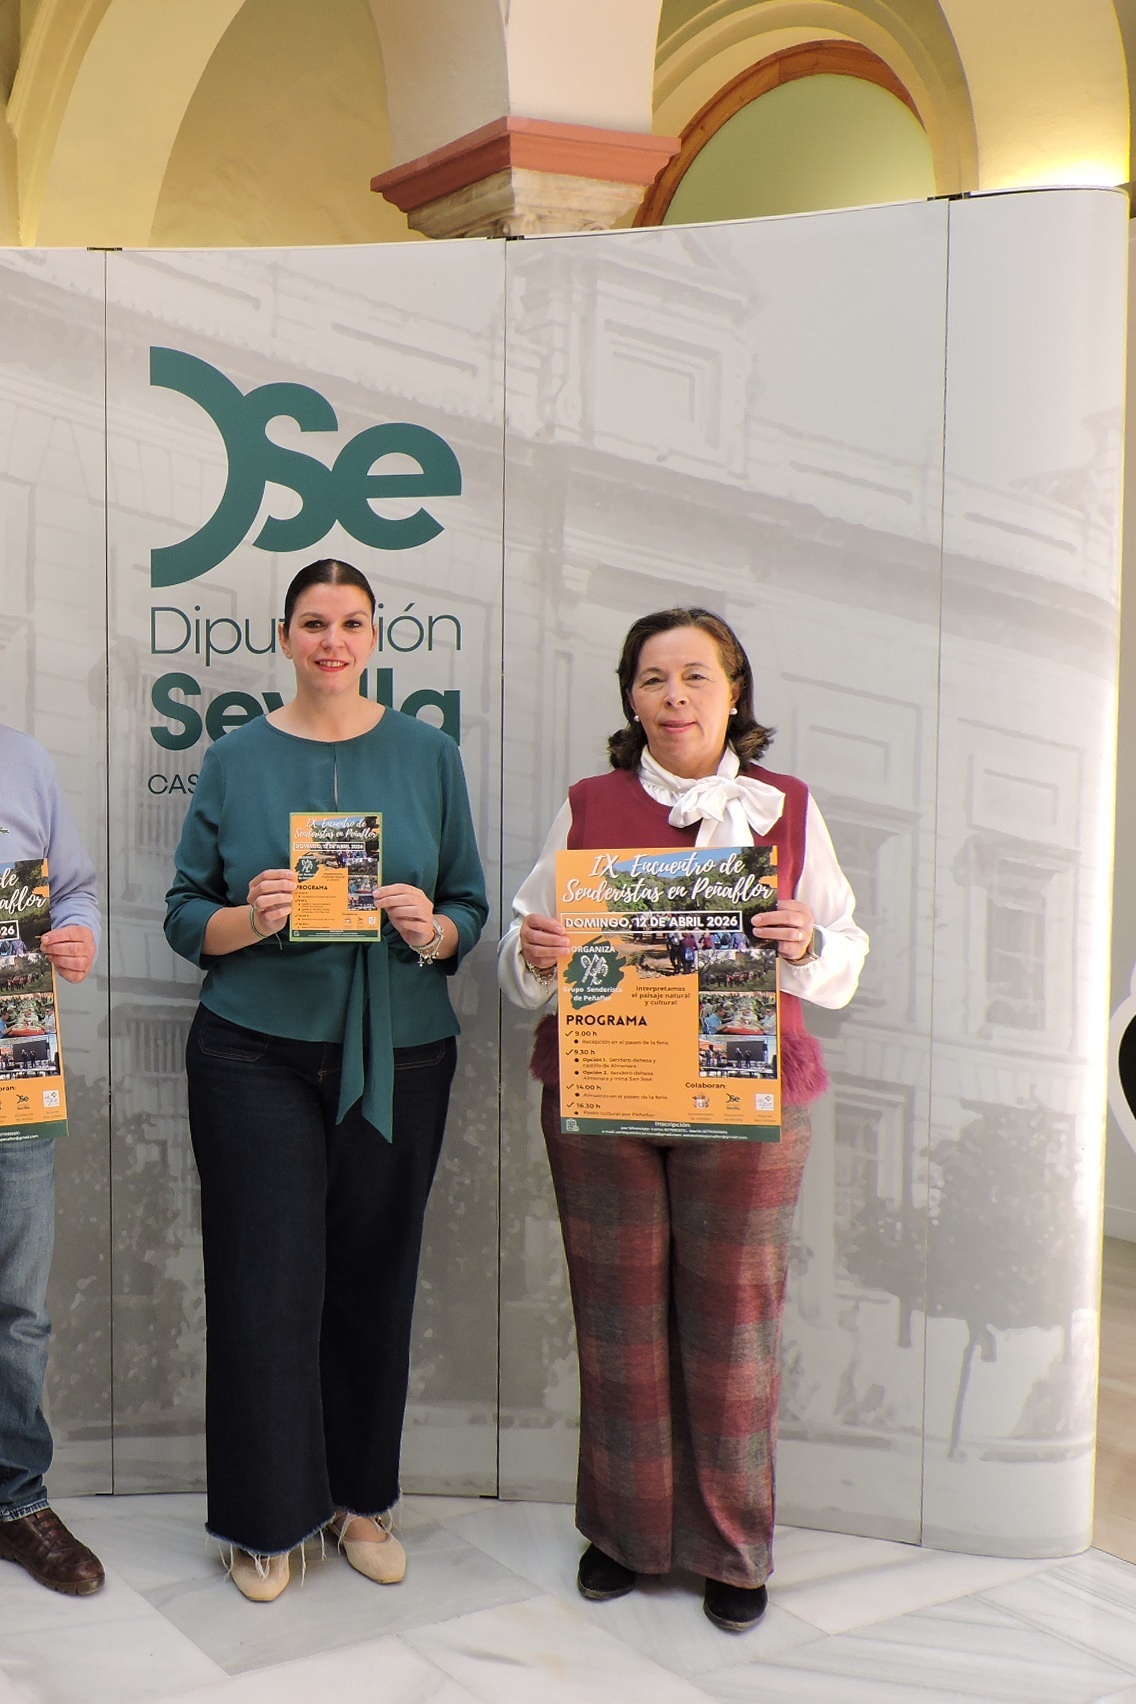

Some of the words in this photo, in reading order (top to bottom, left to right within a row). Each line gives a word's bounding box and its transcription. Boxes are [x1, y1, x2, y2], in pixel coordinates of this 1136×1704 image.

[150, 602, 462, 667] Dipuión
[148, 774, 199, 795] CAS
[588, 853, 619, 878] IX
[631, 851, 717, 879] Encuentro
[719, 853, 745, 875] de
[563, 878, 664, 904] Senderistas
[667, 887, 688, 900] en
[691, 873, 774, 905] Peñaflor
[564, 917, 633, 930] DOMINGO,
[636, 917, 646, 928] 12
[650, 917, 666, 928] DE
[668, 916, 704, 928] ABRIL
[706, 916, 738, 927] 2026
[571, 945, 615, 953] ORGANIZA
[566, 1014, 648, 1026] PROGRAMA
